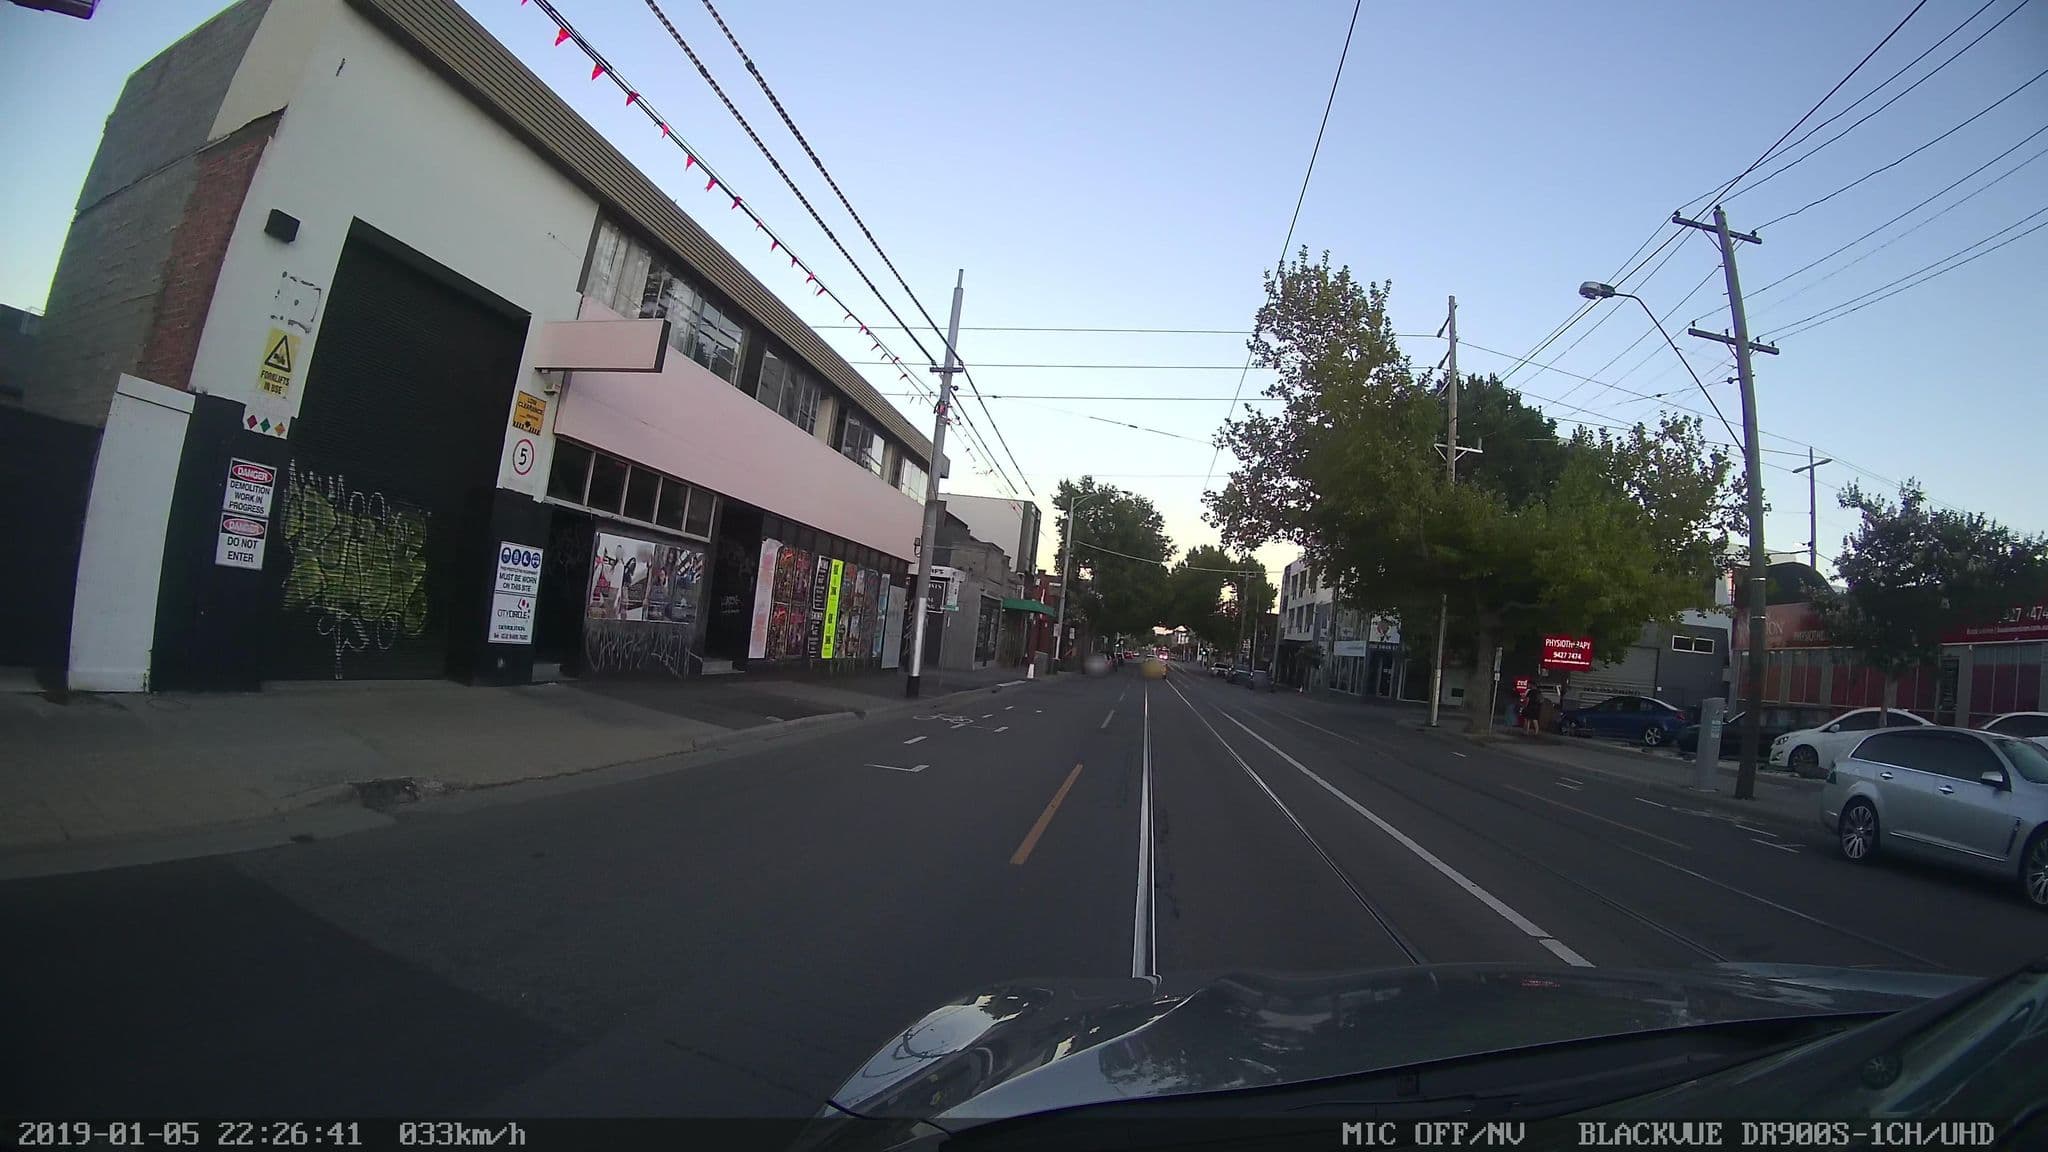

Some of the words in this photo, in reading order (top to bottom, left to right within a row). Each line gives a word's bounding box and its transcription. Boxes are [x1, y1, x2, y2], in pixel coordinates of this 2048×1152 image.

[260, 370, 290, 386] FORKLIFTS
[264, 381, 270, 391] IN
[271, 384, 283, 394] USE
[518, 447, 528, 466] 5
[237, 467, 268, 481] DANGER
[230, 480, 271, 495] DEMOLITION
[234, 492, 255, 502] WORK
[256, 496, 263, 504] IN
[229, 501, 265, 514] PROGRESS
[228, 520, 259, 534] DANGER
[227, 536, 240, 546] DO
[241, 538, 259, 549] NOT
[227, 550, 254, 563] ENTER
[499, 572, 514, 581] MUST
[514, 574, 521, 582] BE
[522, 575, 538, 584] WORN
[511, 583, 521, 591] THIS
